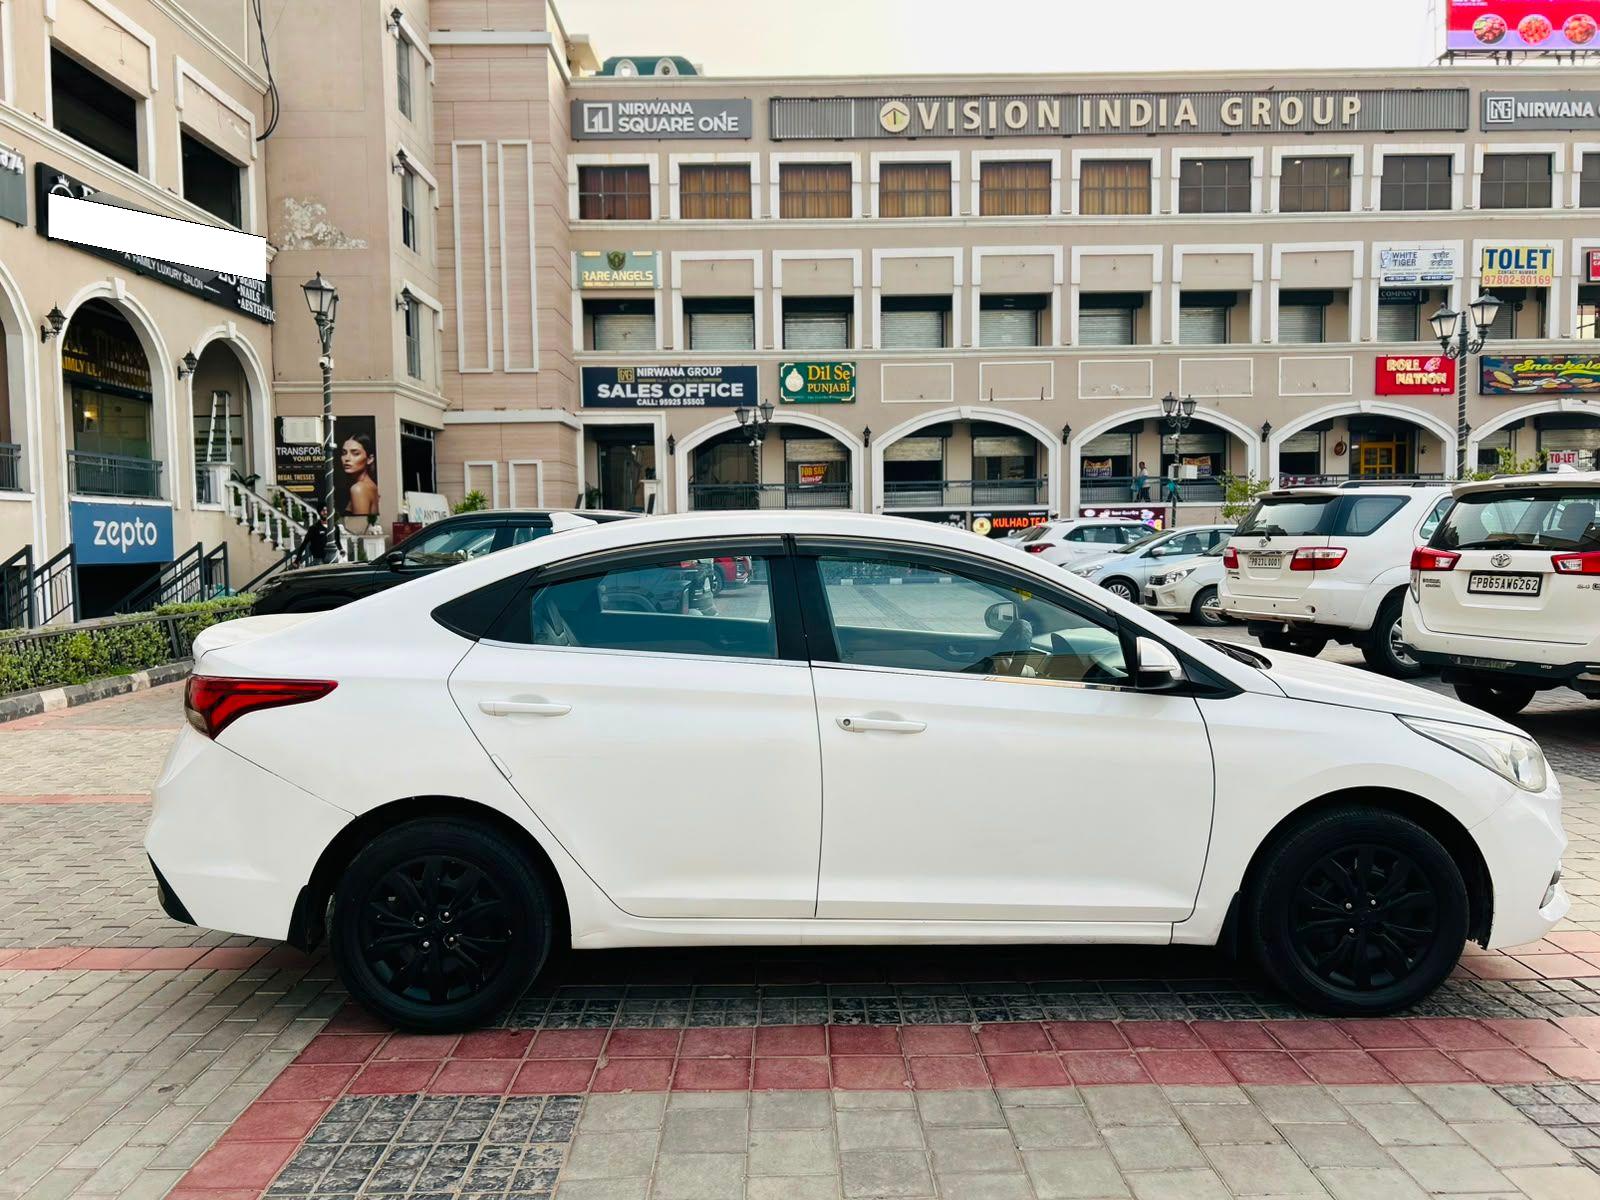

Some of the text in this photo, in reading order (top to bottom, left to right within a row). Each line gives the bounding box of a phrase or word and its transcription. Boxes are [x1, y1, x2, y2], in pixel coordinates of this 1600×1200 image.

[618, 102, 693, 115] NIRWANA
[918, 95, 1362, 131] VISION INDIA GROUP
[1517, 102, 1595, 117] NIRWANA
[618, 111, 739, 133] SQUARE ONE
[1485, 248, 1552, 270] TOLET
[132, 254, 158, 270] FAMILY
[157, 261, 183, 282] LUXURY
[182, 272, 204, 290] SALON
[582, 270, 654, 281] RARE ANGELS
[239, 276, 266, 294] BEAUTY
[1484, 275, 1552, 285] 97802-80169
[239, 285, 261, 303] NAILS
[240, 299, 276, 322] AESTHETIC
[636, 367, 686, 377] NIRWANA
[687, 367, 723, 377] GROUP
[807, 364, 851, 380] Dil Se
[1386, 358, 1422, 371] ROLL
[1395, 372, 1447, 385] NATION
[597, 382, 744, 399] SALES OFFICE
[276, 446, 324, 456] TRANSFOR
[1550, 453, 1576, 463] TO-LET
[813, 467, 827, 475] SAL
[992, 517, 1047, 528] KULHAD TEA
[93, 516, 158, 554] zepto
